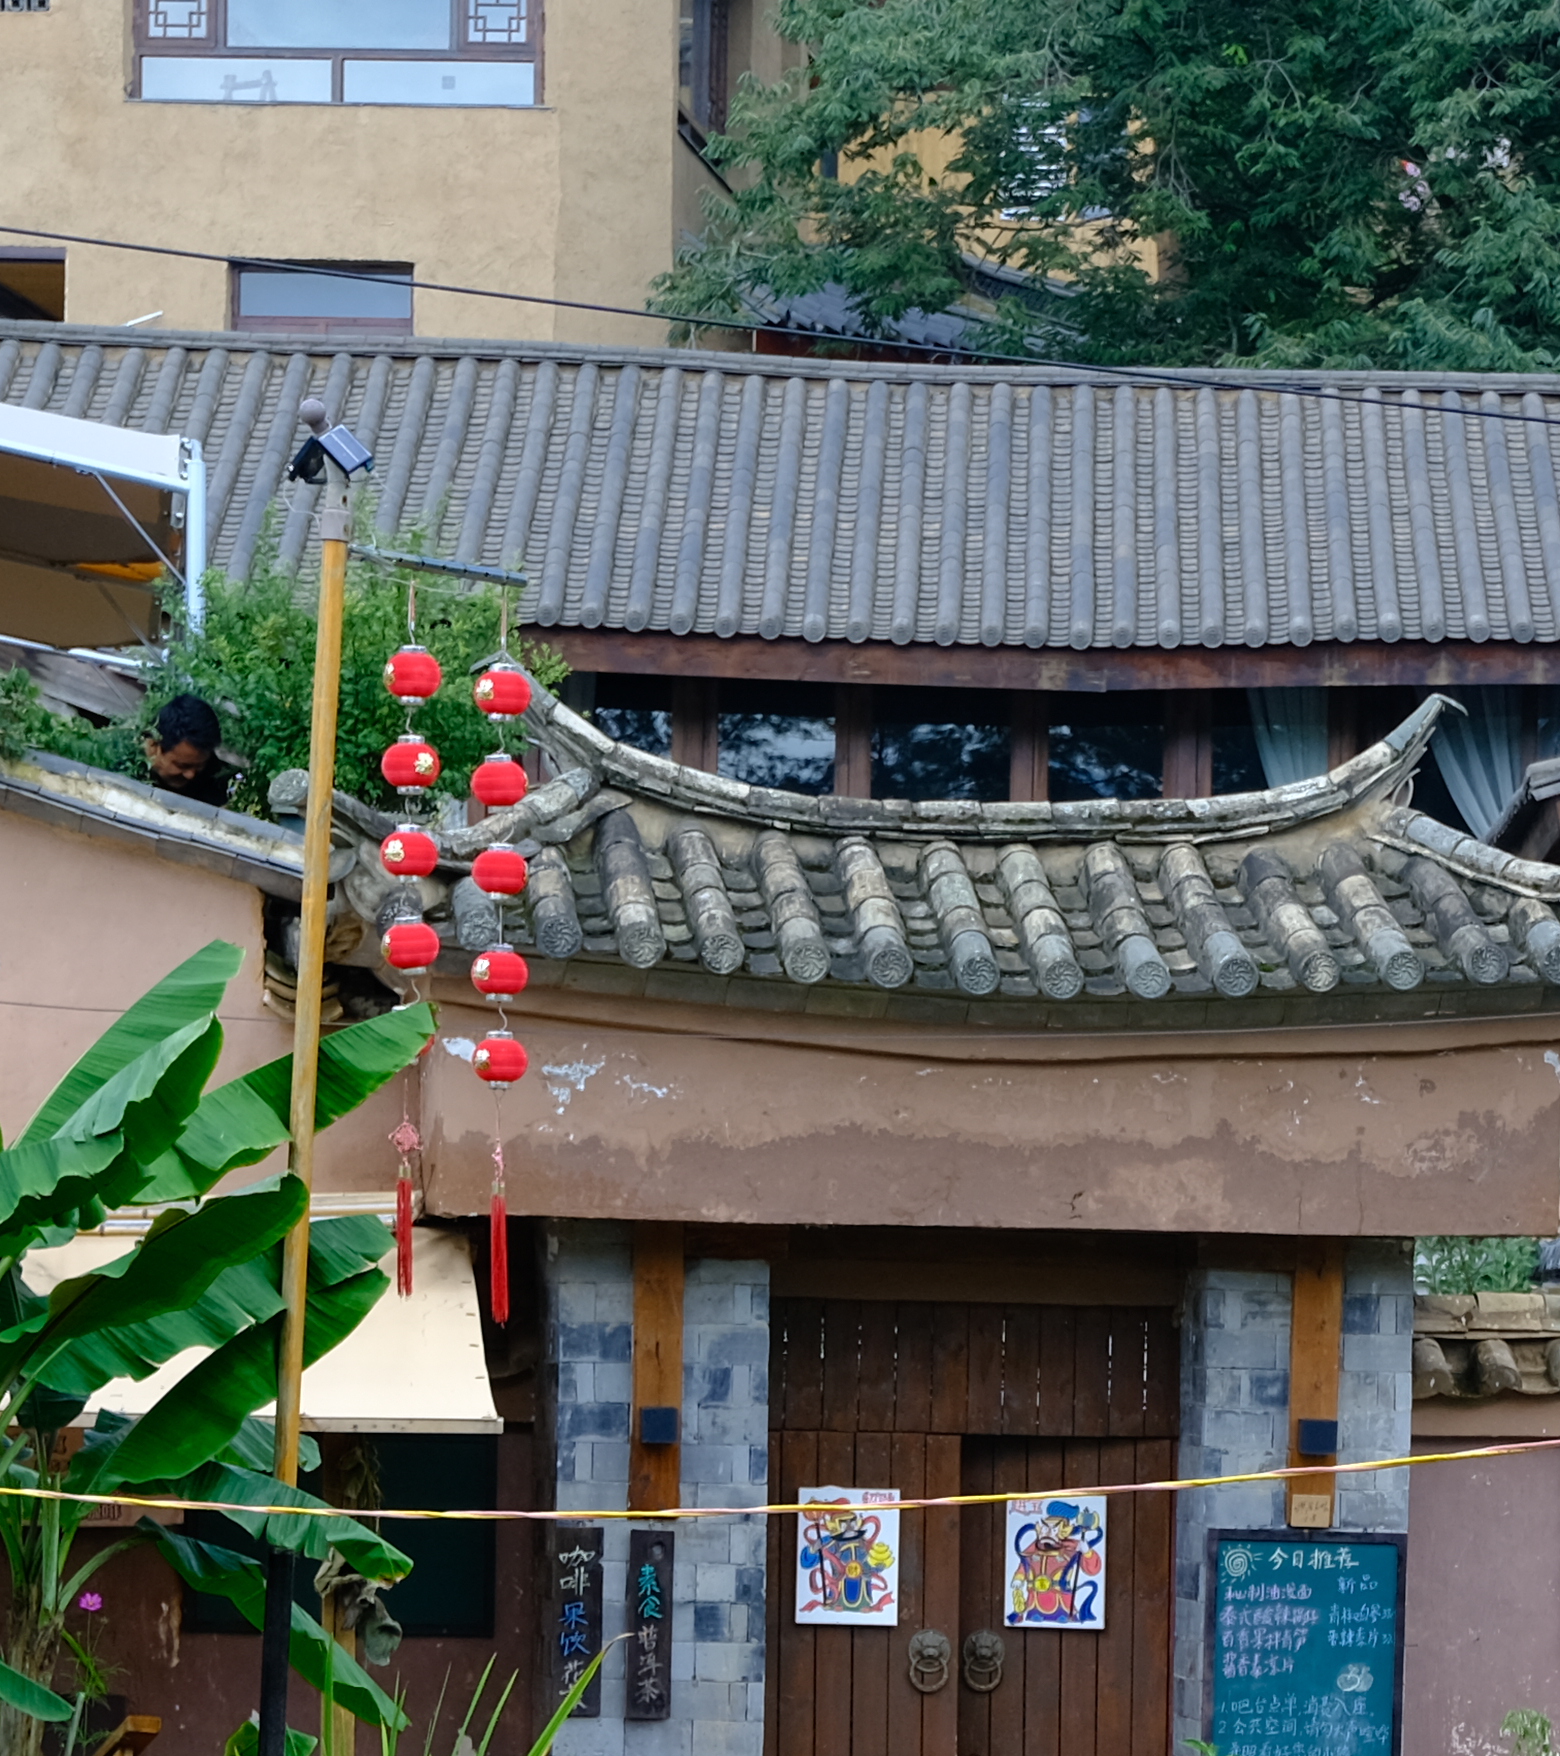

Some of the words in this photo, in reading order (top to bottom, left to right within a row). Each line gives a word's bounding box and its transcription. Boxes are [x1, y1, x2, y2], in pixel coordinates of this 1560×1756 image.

[1268, 1546, 1359, 1570] 今日推荐
[1337, 1573, 1378, 1594] 新品
